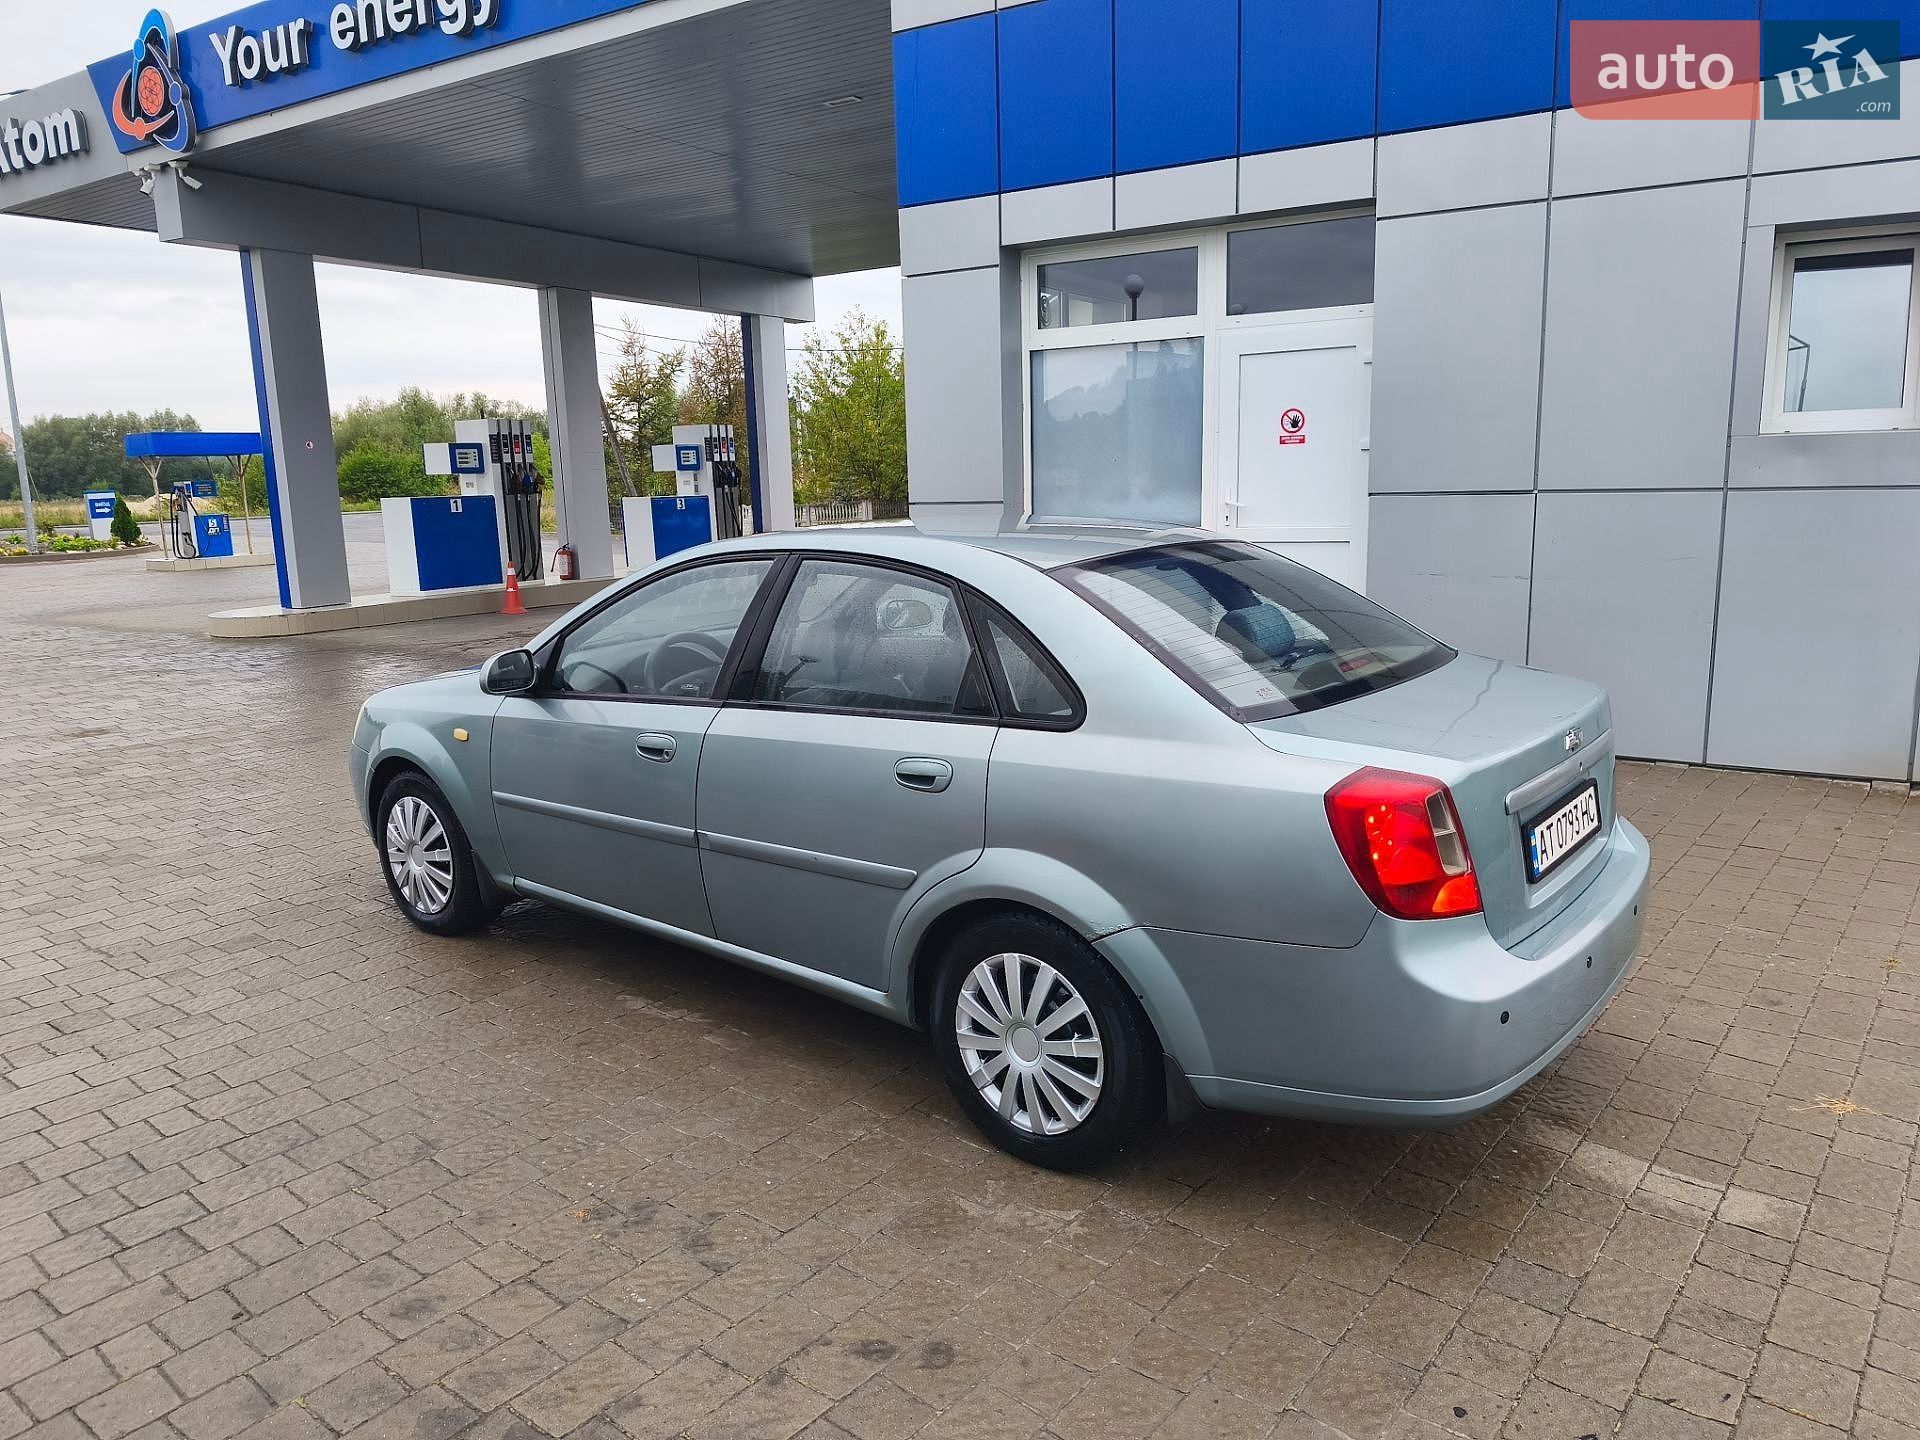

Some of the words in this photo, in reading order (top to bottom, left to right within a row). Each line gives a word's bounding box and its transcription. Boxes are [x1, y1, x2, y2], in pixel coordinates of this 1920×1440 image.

[208, 17, 306, 87] Your
[452, 500, 460, 512] 1
[677, 499, 685, 509] 3
[1556, 803, 1581, 849] 0793
